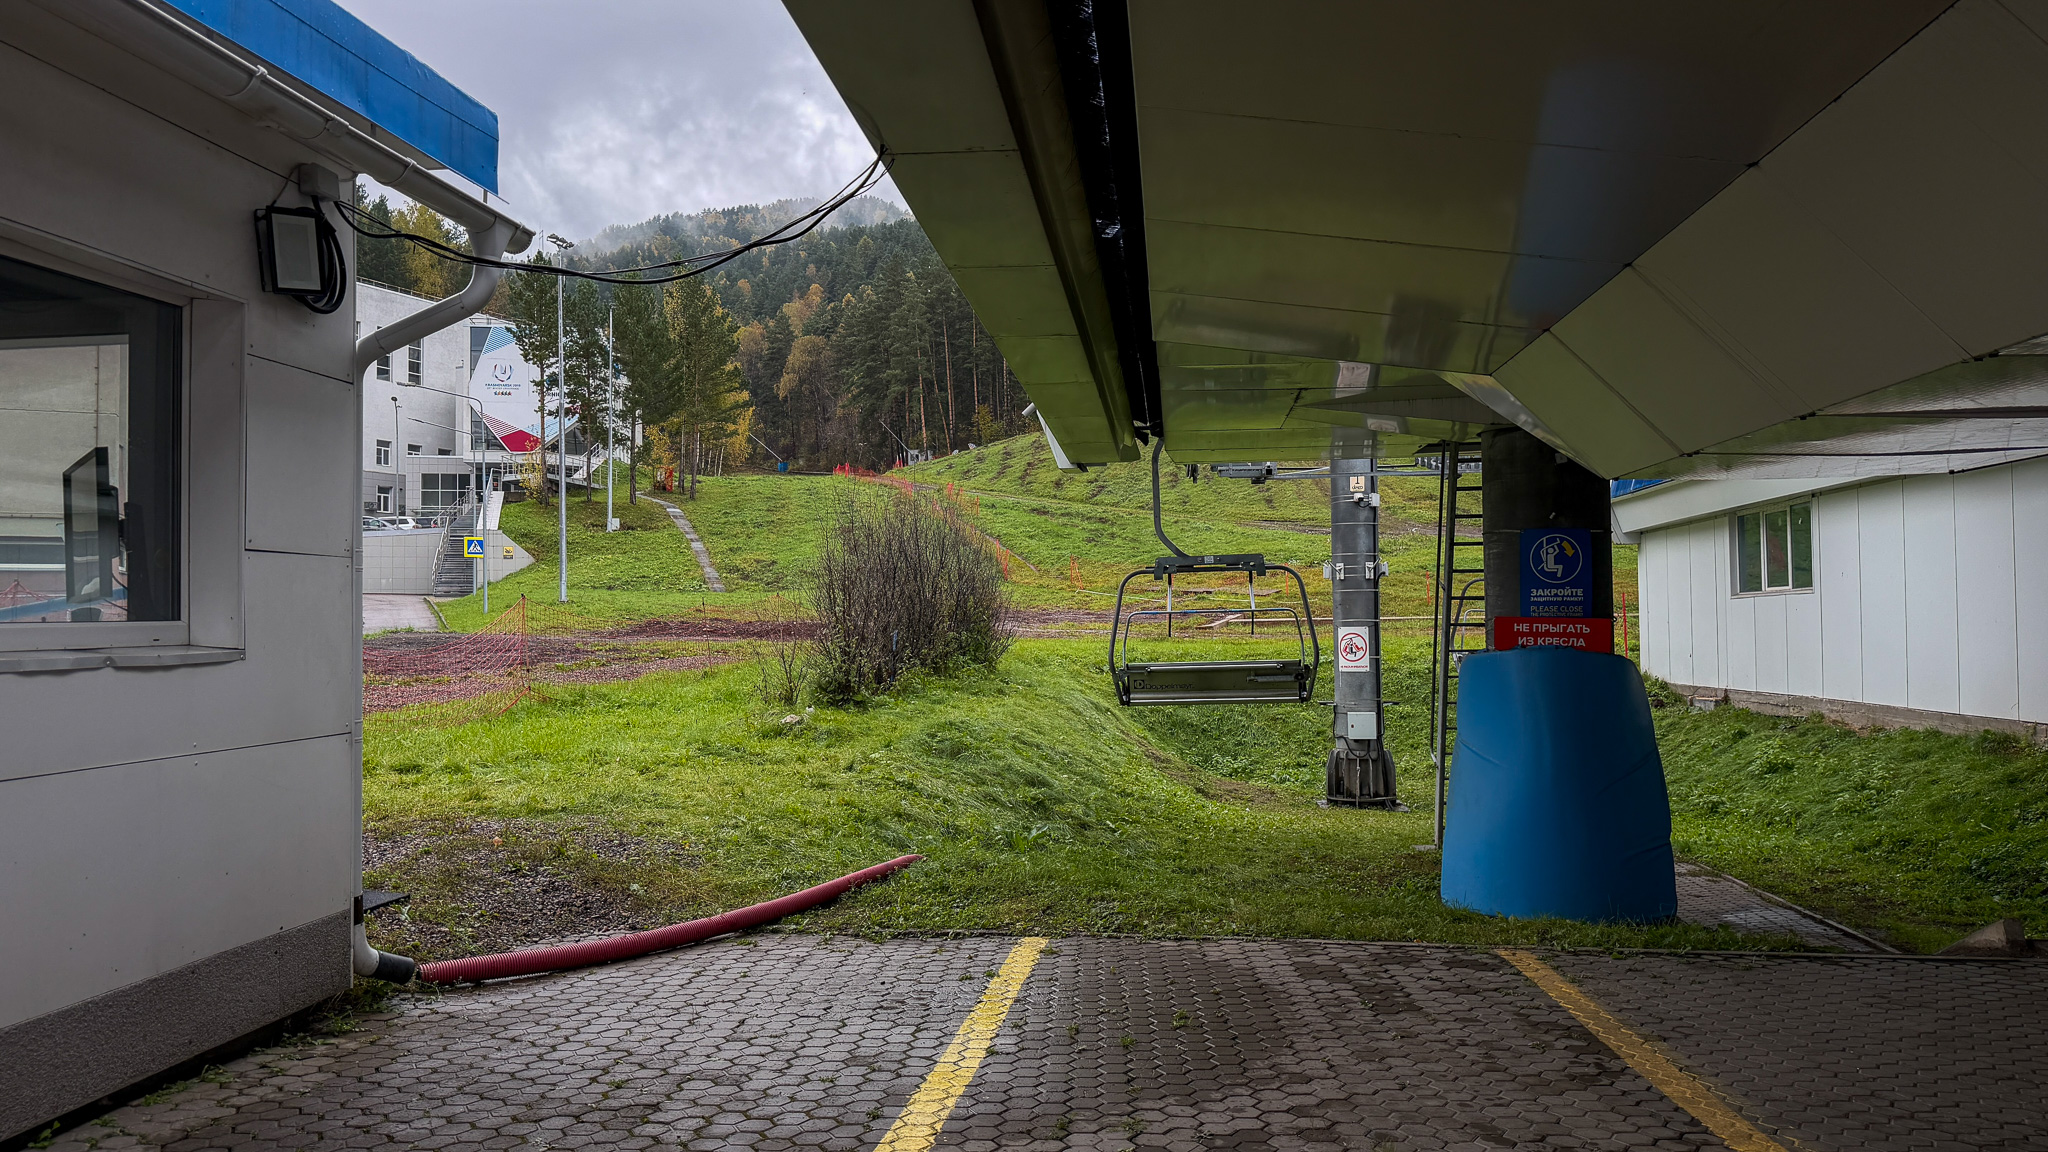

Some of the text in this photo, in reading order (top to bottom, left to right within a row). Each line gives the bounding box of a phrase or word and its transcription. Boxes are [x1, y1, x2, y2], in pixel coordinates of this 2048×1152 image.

[1530, 587, 1584, 596] ЗАКРОЙТЕ
[1530, 605, 1584, 613] PLEASE CLOSE
[1513, 623, 1591, 633] НЕ ПРЫГАТЬ
[1518, 636, 1586, 647] ИЗ КРЕСЛА
